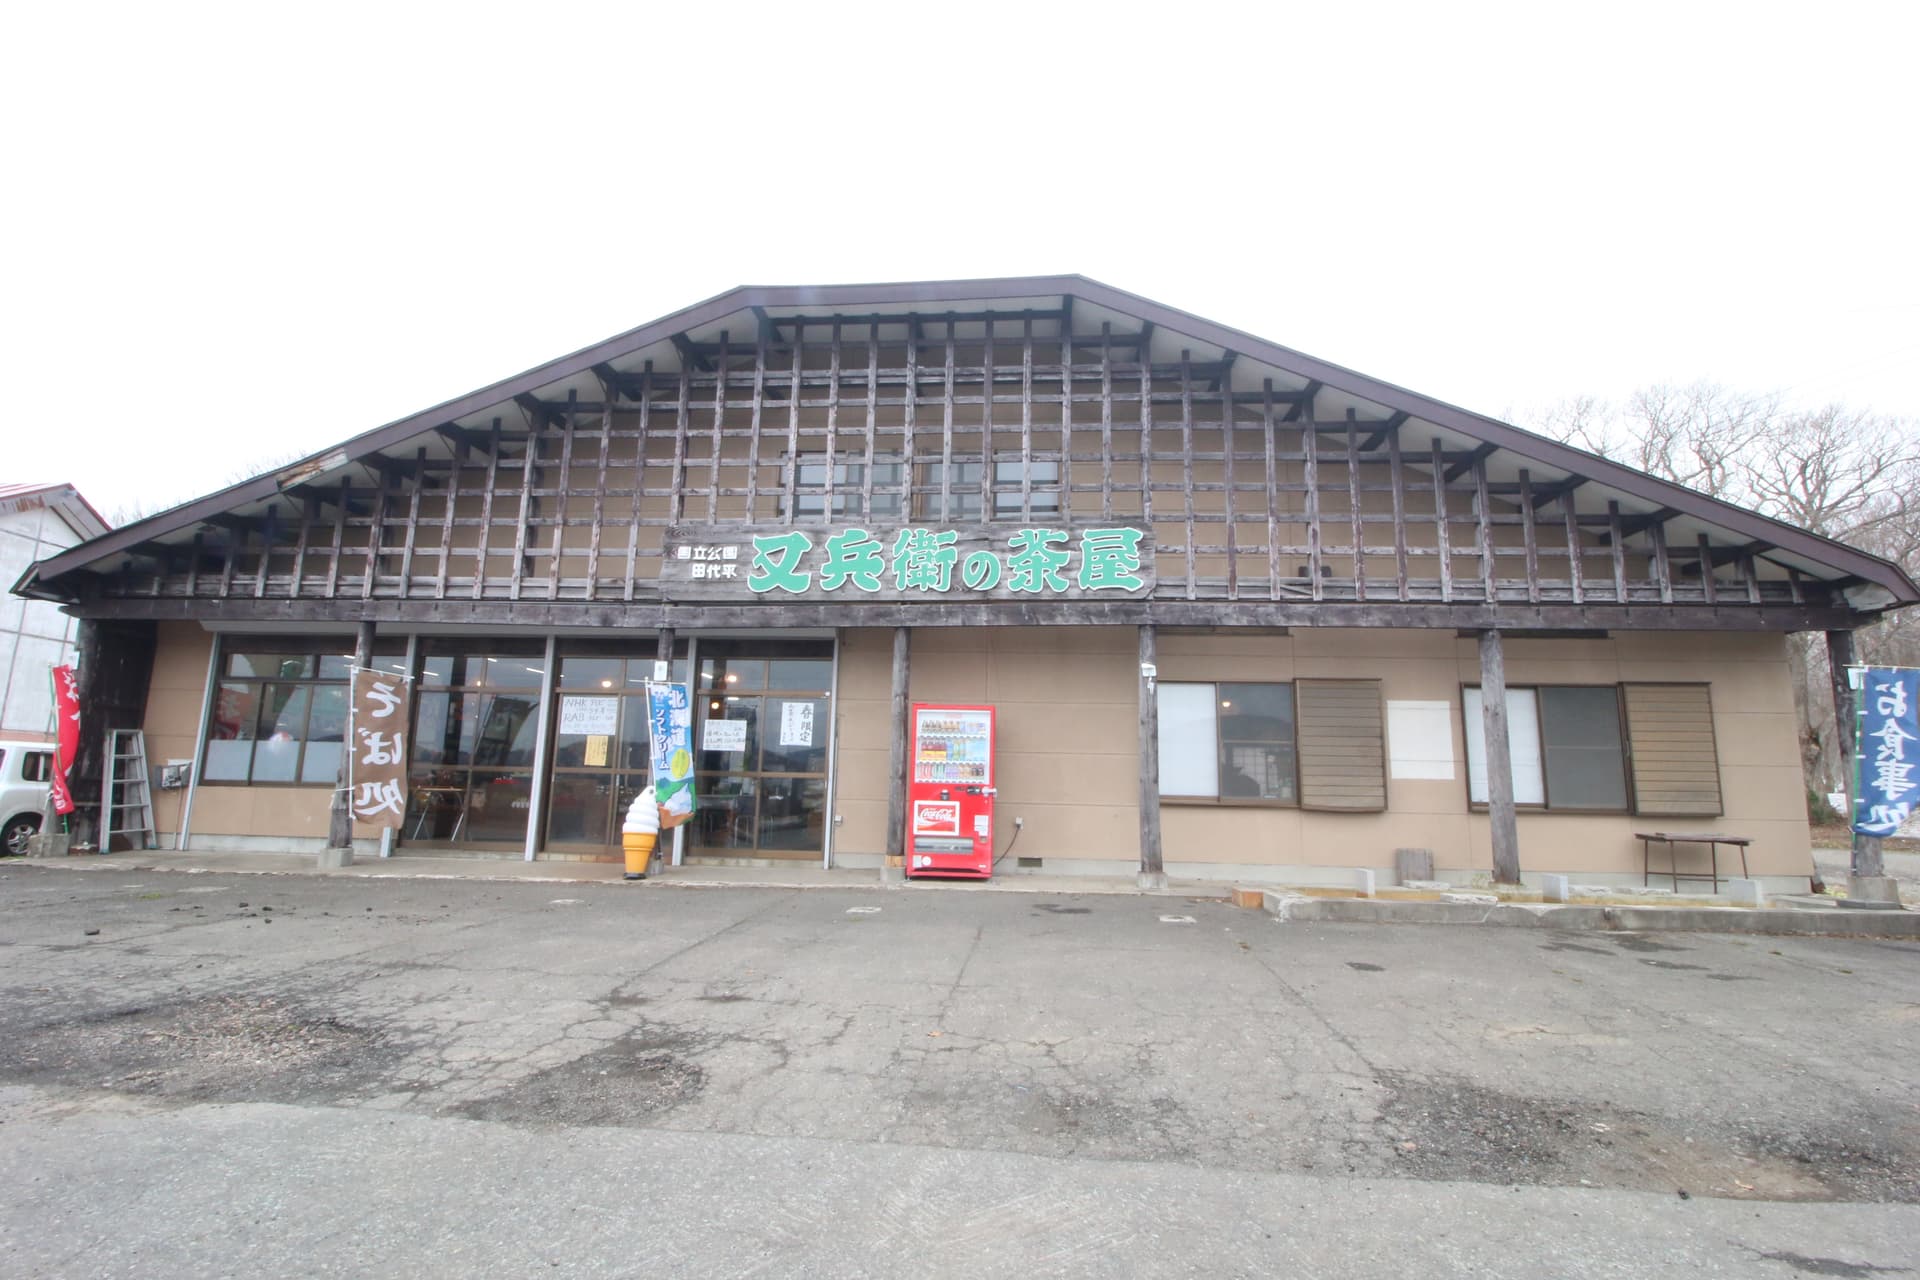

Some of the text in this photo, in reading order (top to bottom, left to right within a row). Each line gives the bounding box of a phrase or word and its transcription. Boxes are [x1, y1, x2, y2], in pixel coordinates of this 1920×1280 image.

[692, 563, 738, 578] 田代平
[748, 527, 1143, 593] 又兵衛の茶屋
[668, 690, 689, 746] 北海道
